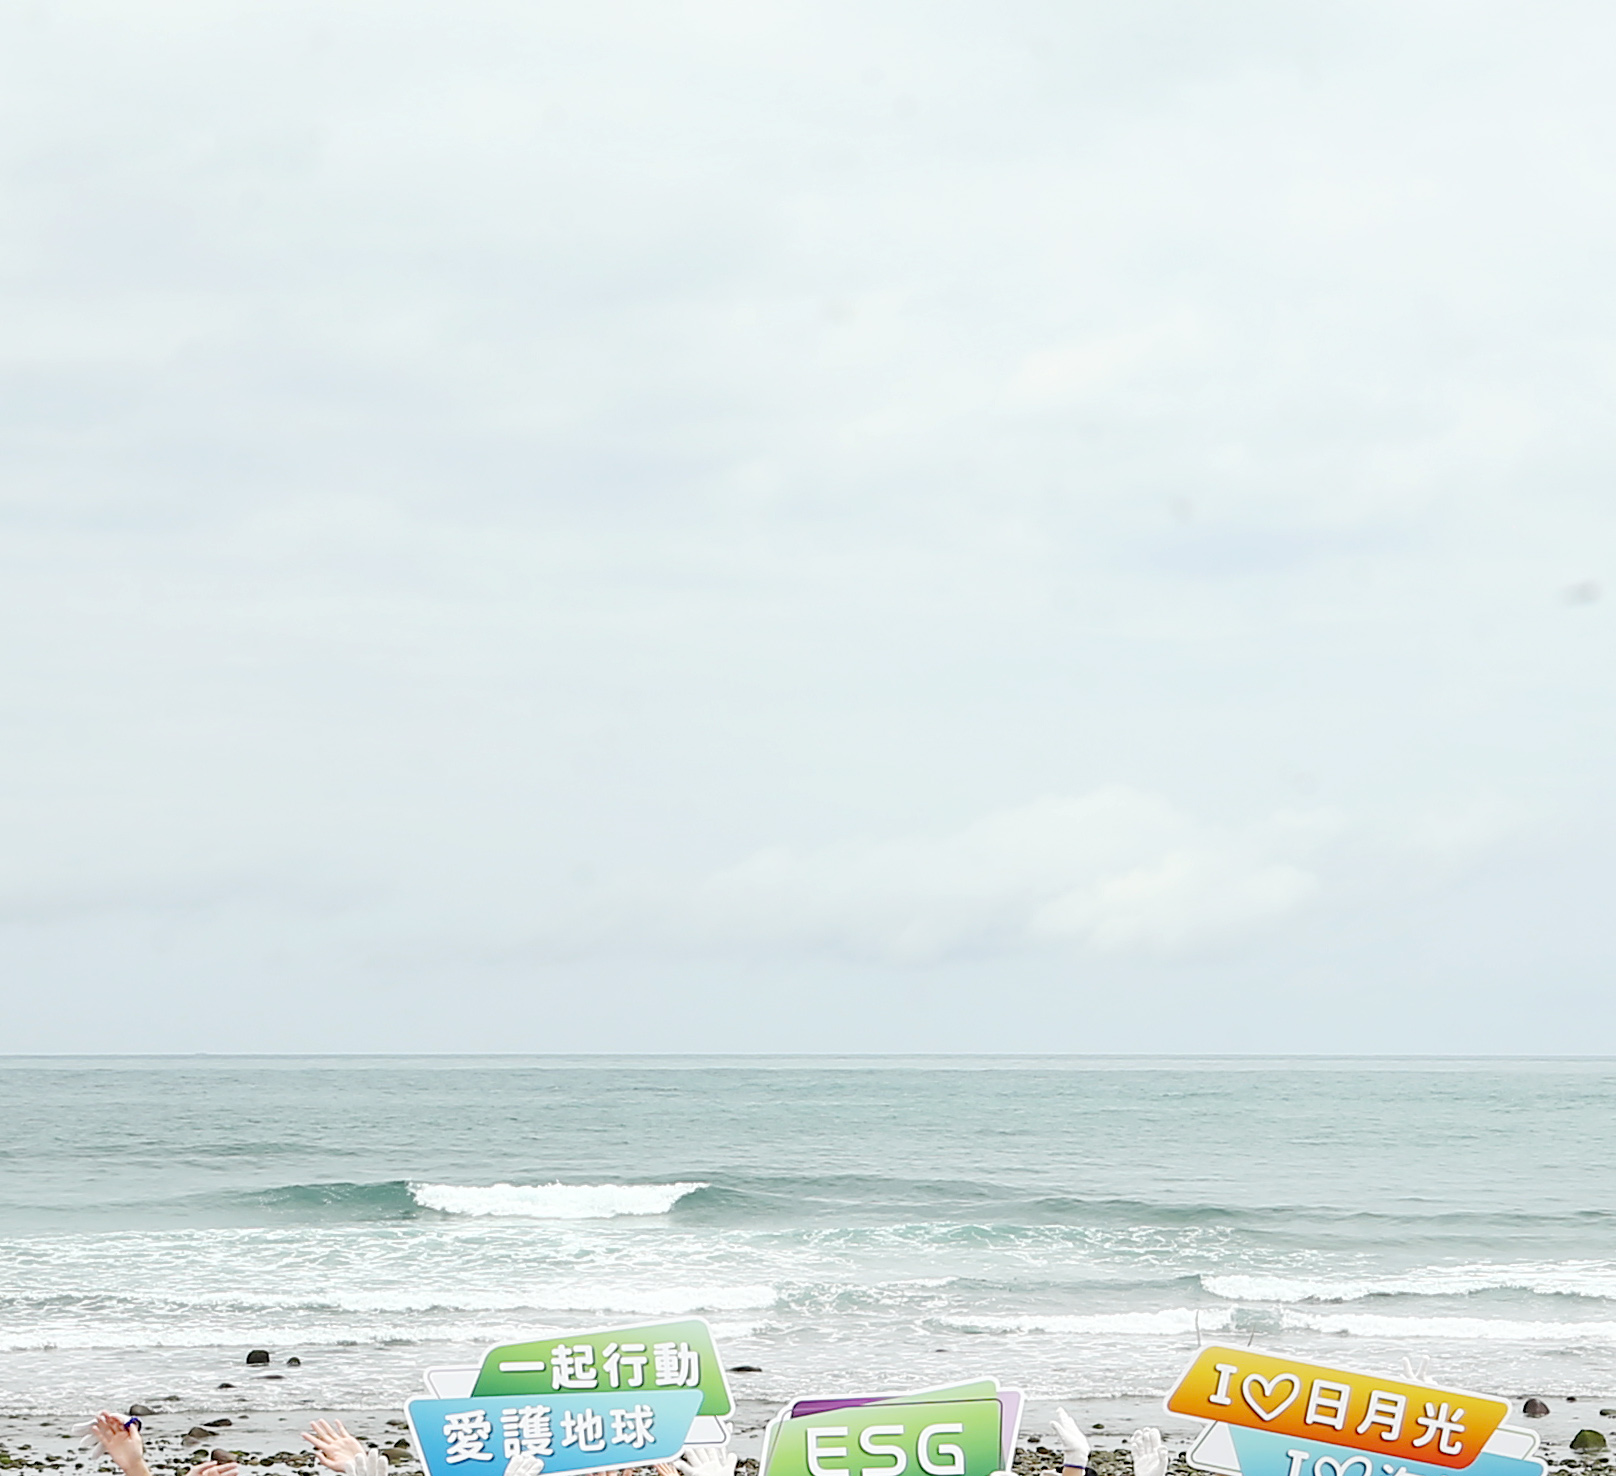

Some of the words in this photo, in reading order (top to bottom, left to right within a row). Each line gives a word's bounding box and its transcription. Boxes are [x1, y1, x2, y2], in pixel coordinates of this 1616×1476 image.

[498, 1340, 701, 1390] 一起行動
[442, 1404, 656, 1464] 愛護地球
[1304, 1377, 1468, 1456] 日月光
